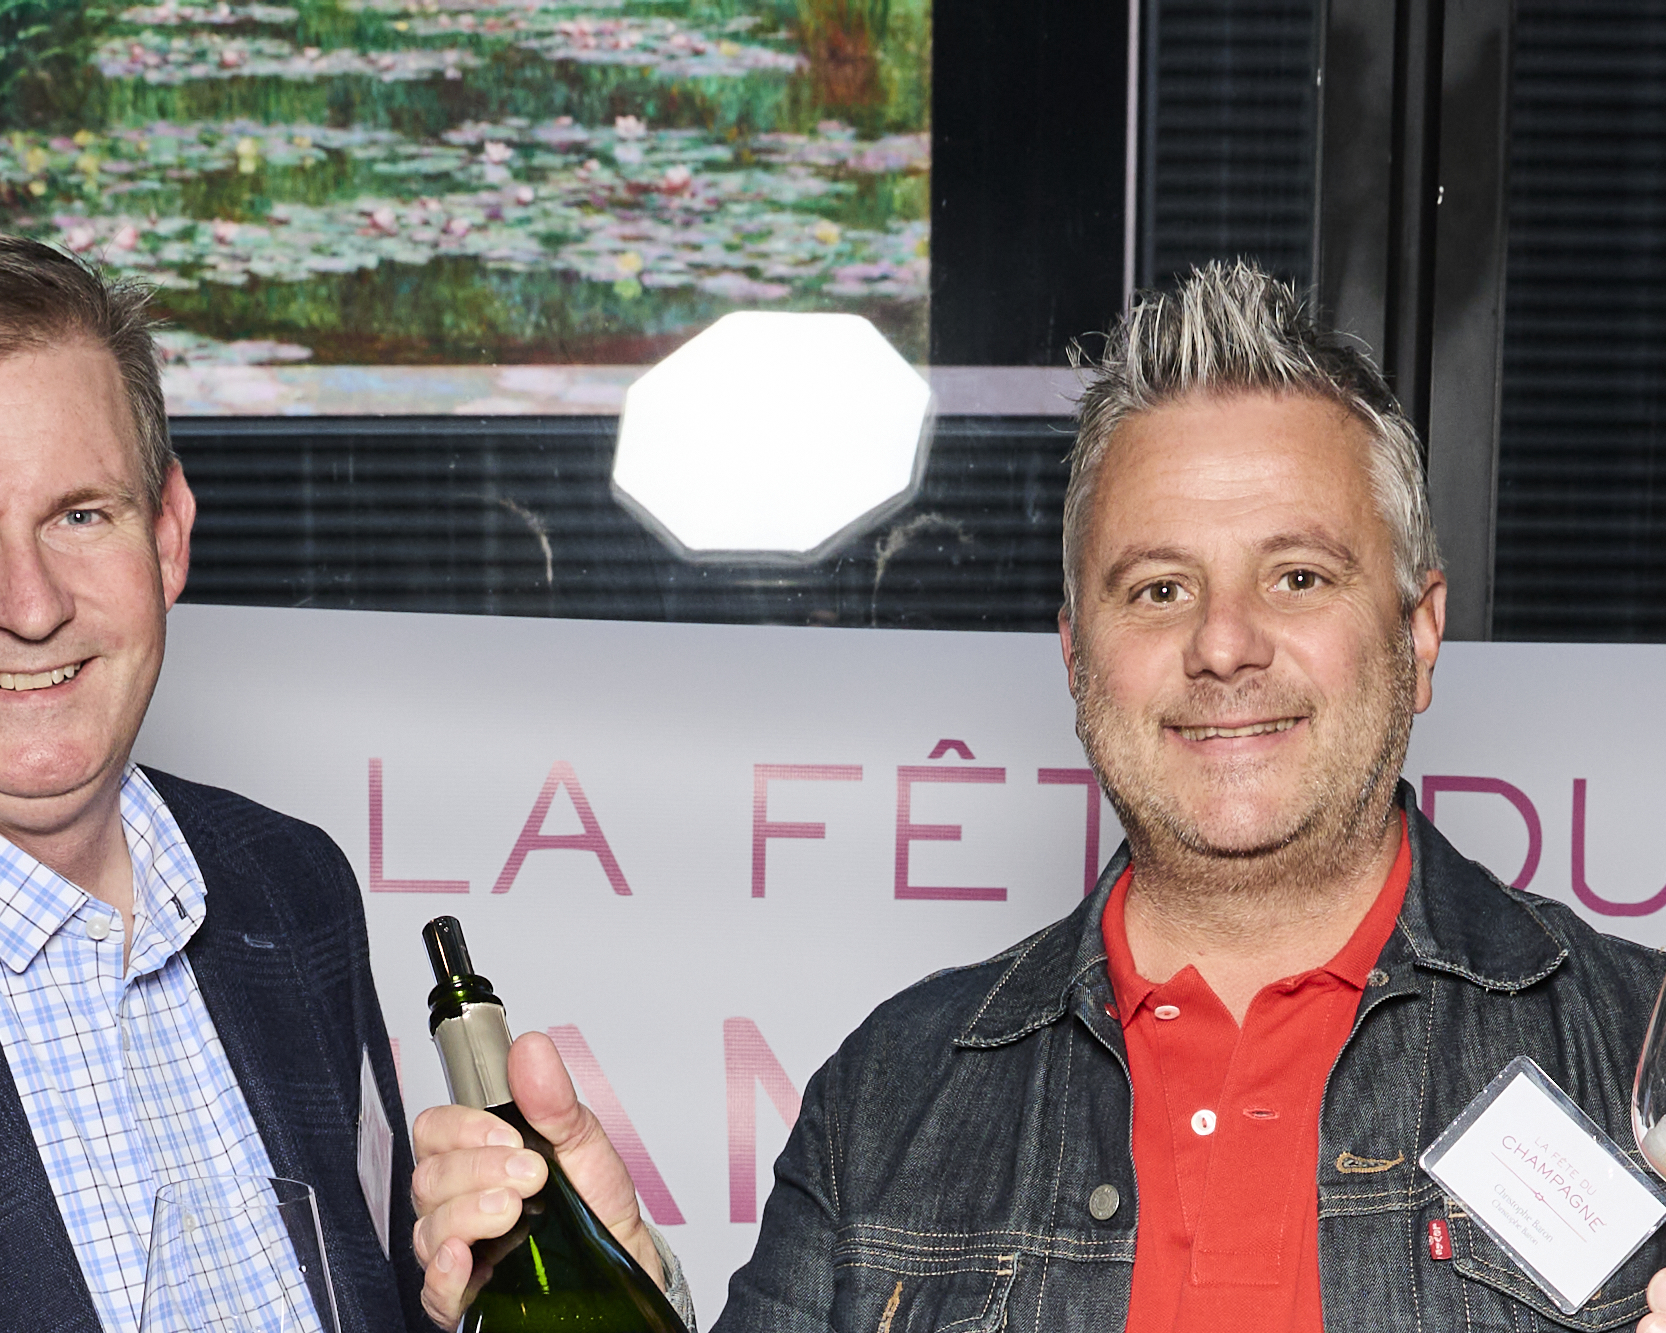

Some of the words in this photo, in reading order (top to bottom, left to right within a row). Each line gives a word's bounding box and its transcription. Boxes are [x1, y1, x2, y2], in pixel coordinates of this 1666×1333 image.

[367, 757, 633, 897] LA
[750, 738, 1105, 902] FÊT
[1502, 1135, 1607, 1233] CHAMPAGNE
[1534, 1136, 1549, 1153] LA
[1551, 1151, 1580, 1180] FÊTE
[1579, 1179, 1597, 1196] DU
[1494, 1184, 1533, 1223] Christophe
[1532, 1219, 1554, 1243] Baron
